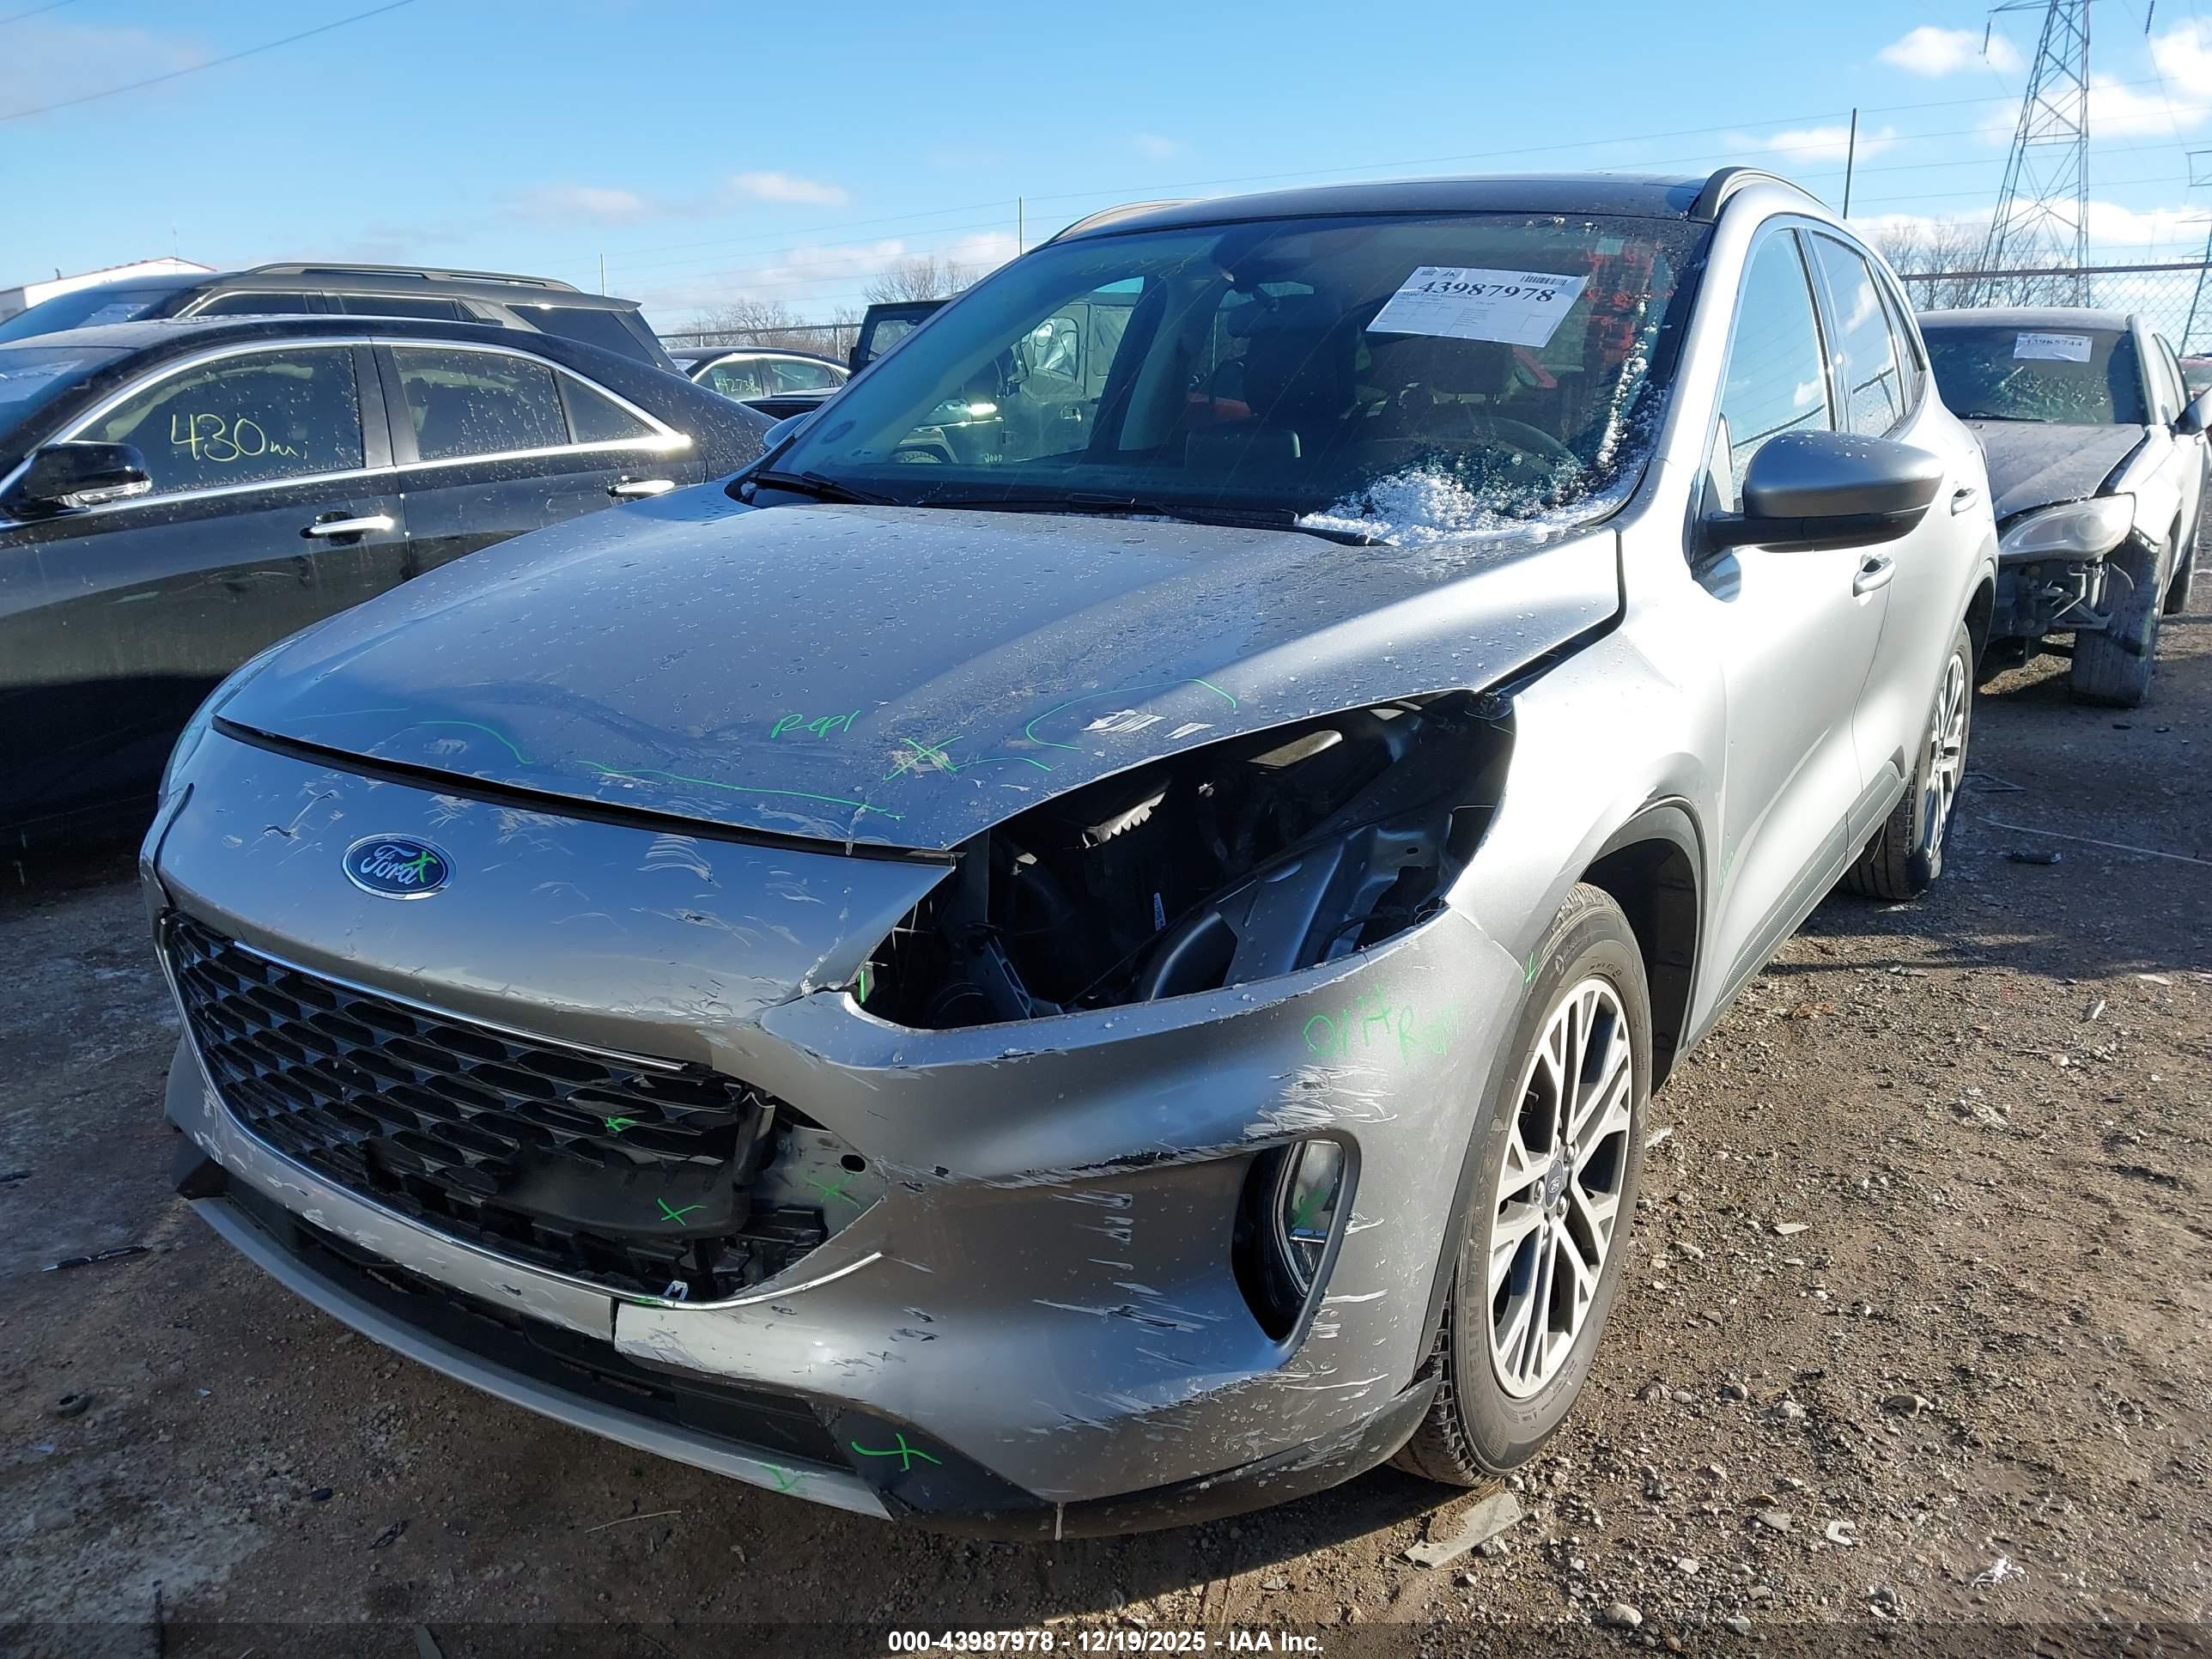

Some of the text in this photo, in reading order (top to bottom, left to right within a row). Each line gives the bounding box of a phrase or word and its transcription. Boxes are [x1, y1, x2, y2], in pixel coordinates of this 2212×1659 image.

[1418, 281, 1556, 302] 43987978
[171, 413, 265, 462] 430
[359, 844, 418, 885] Ford
